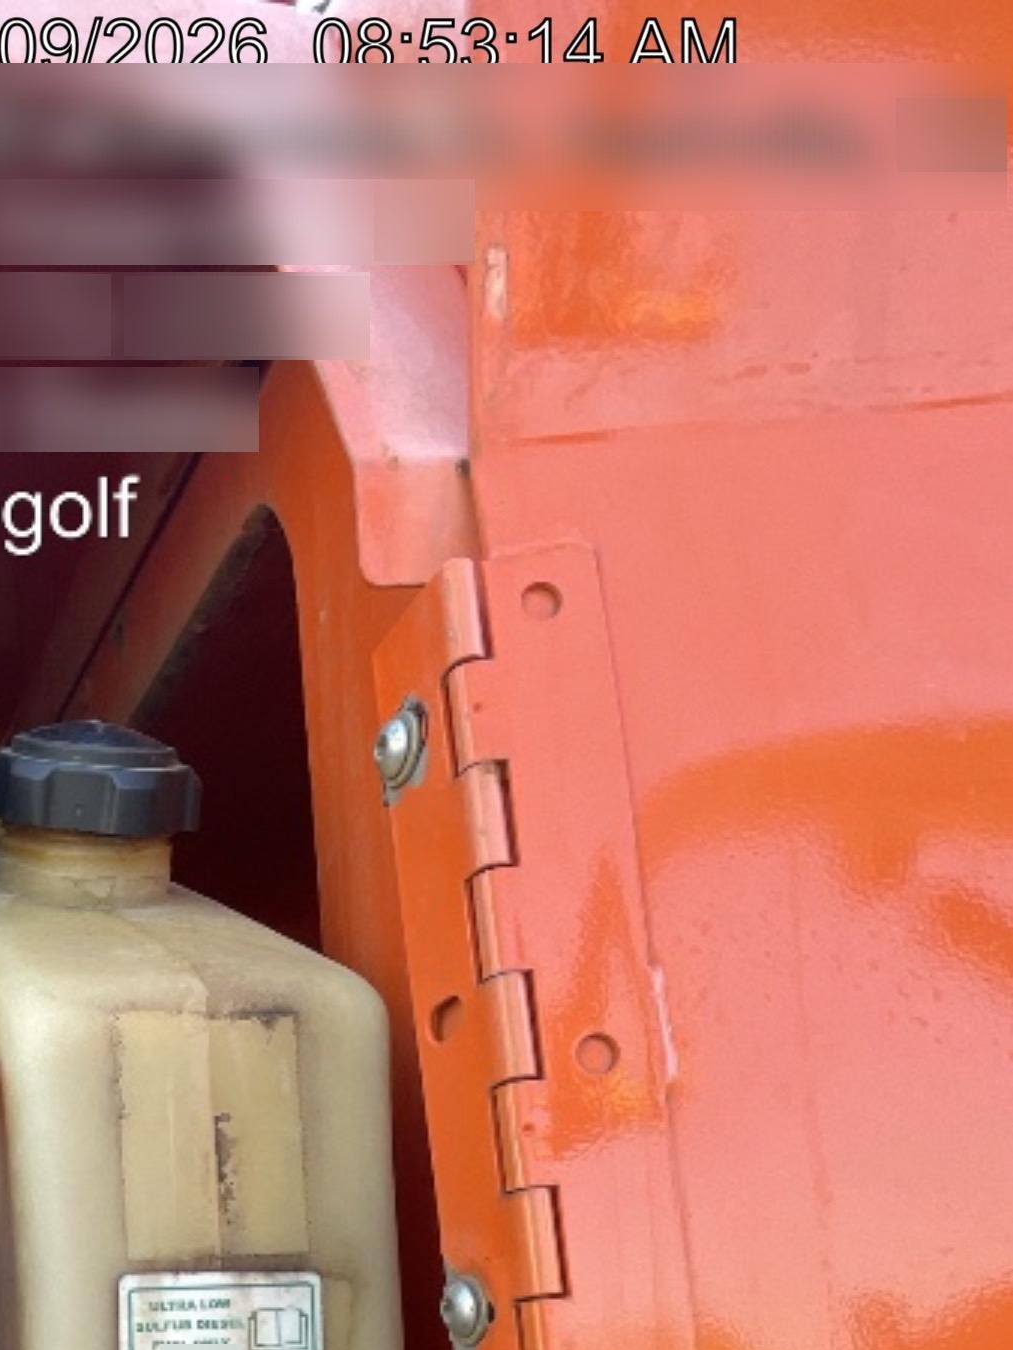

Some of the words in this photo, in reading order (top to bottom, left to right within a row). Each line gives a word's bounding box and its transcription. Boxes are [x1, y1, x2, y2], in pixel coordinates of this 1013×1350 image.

[148, 1300, 197, 1312] ULTRA
[200, 1297, 231, 1309] LOW
[136, 1319, 192, 1333] SULFUR
[196, 1317, 246, 1330] DIESEL
